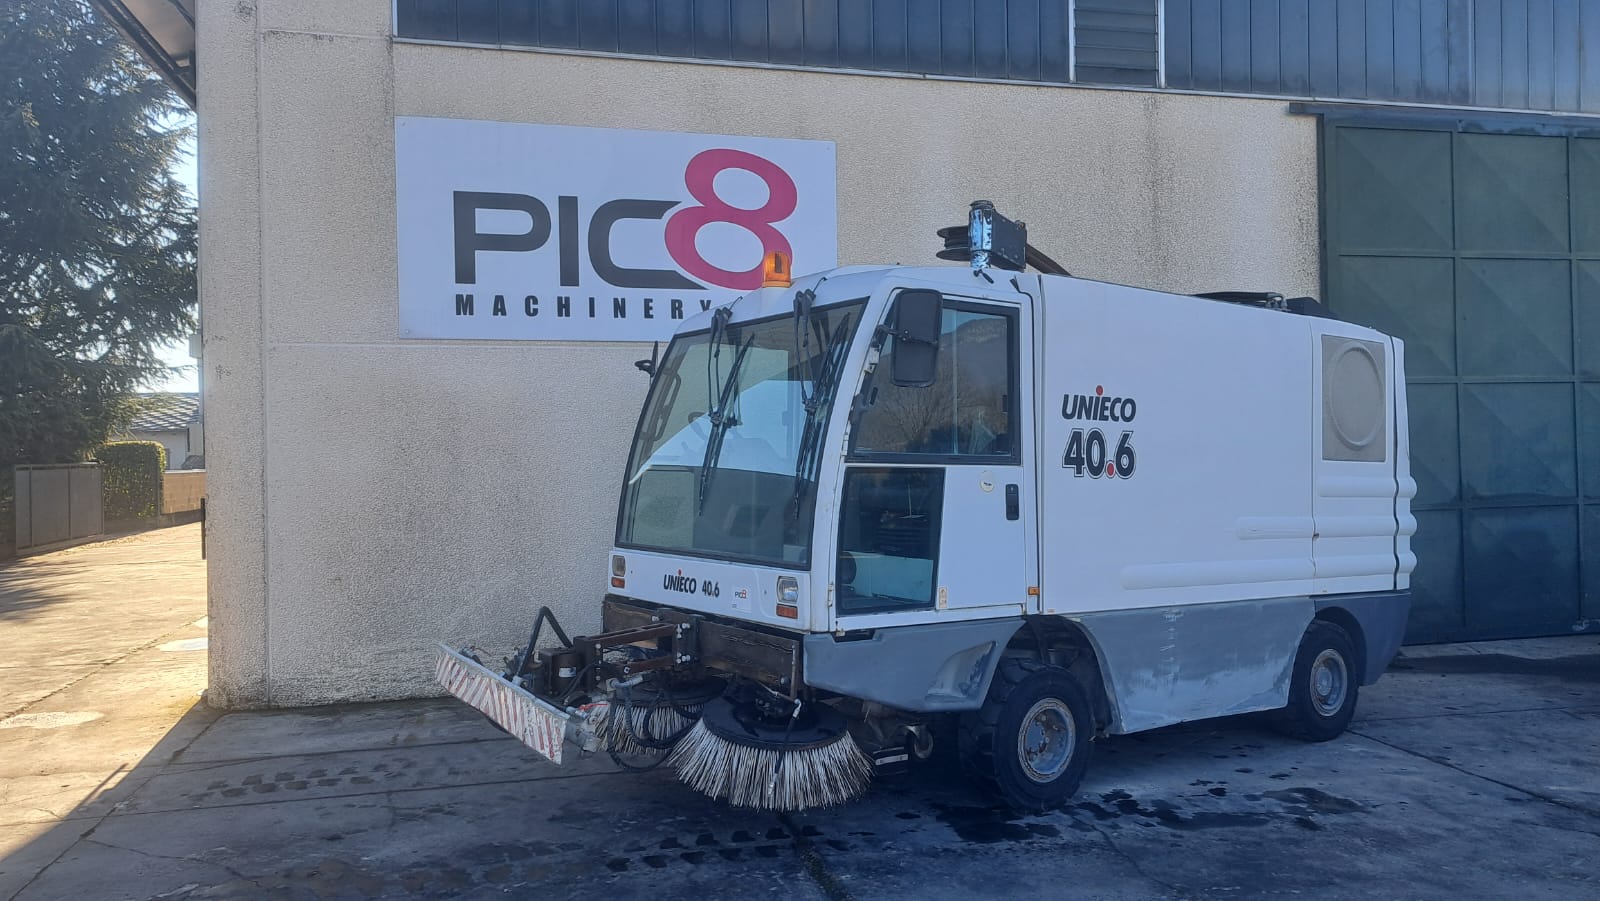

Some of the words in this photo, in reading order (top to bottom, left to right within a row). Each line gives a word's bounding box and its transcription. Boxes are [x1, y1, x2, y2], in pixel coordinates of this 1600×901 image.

[453, 148, 797, 290] PIC8
[455, 294, 712, 319] MACHINERY
[1061, 385, 1137, 423] UNIECO
[1062, 427, 1137, 480] 40.6
[663, 569, 697, 594] UNIECO
[702, 580, 720, 598] 40.6
